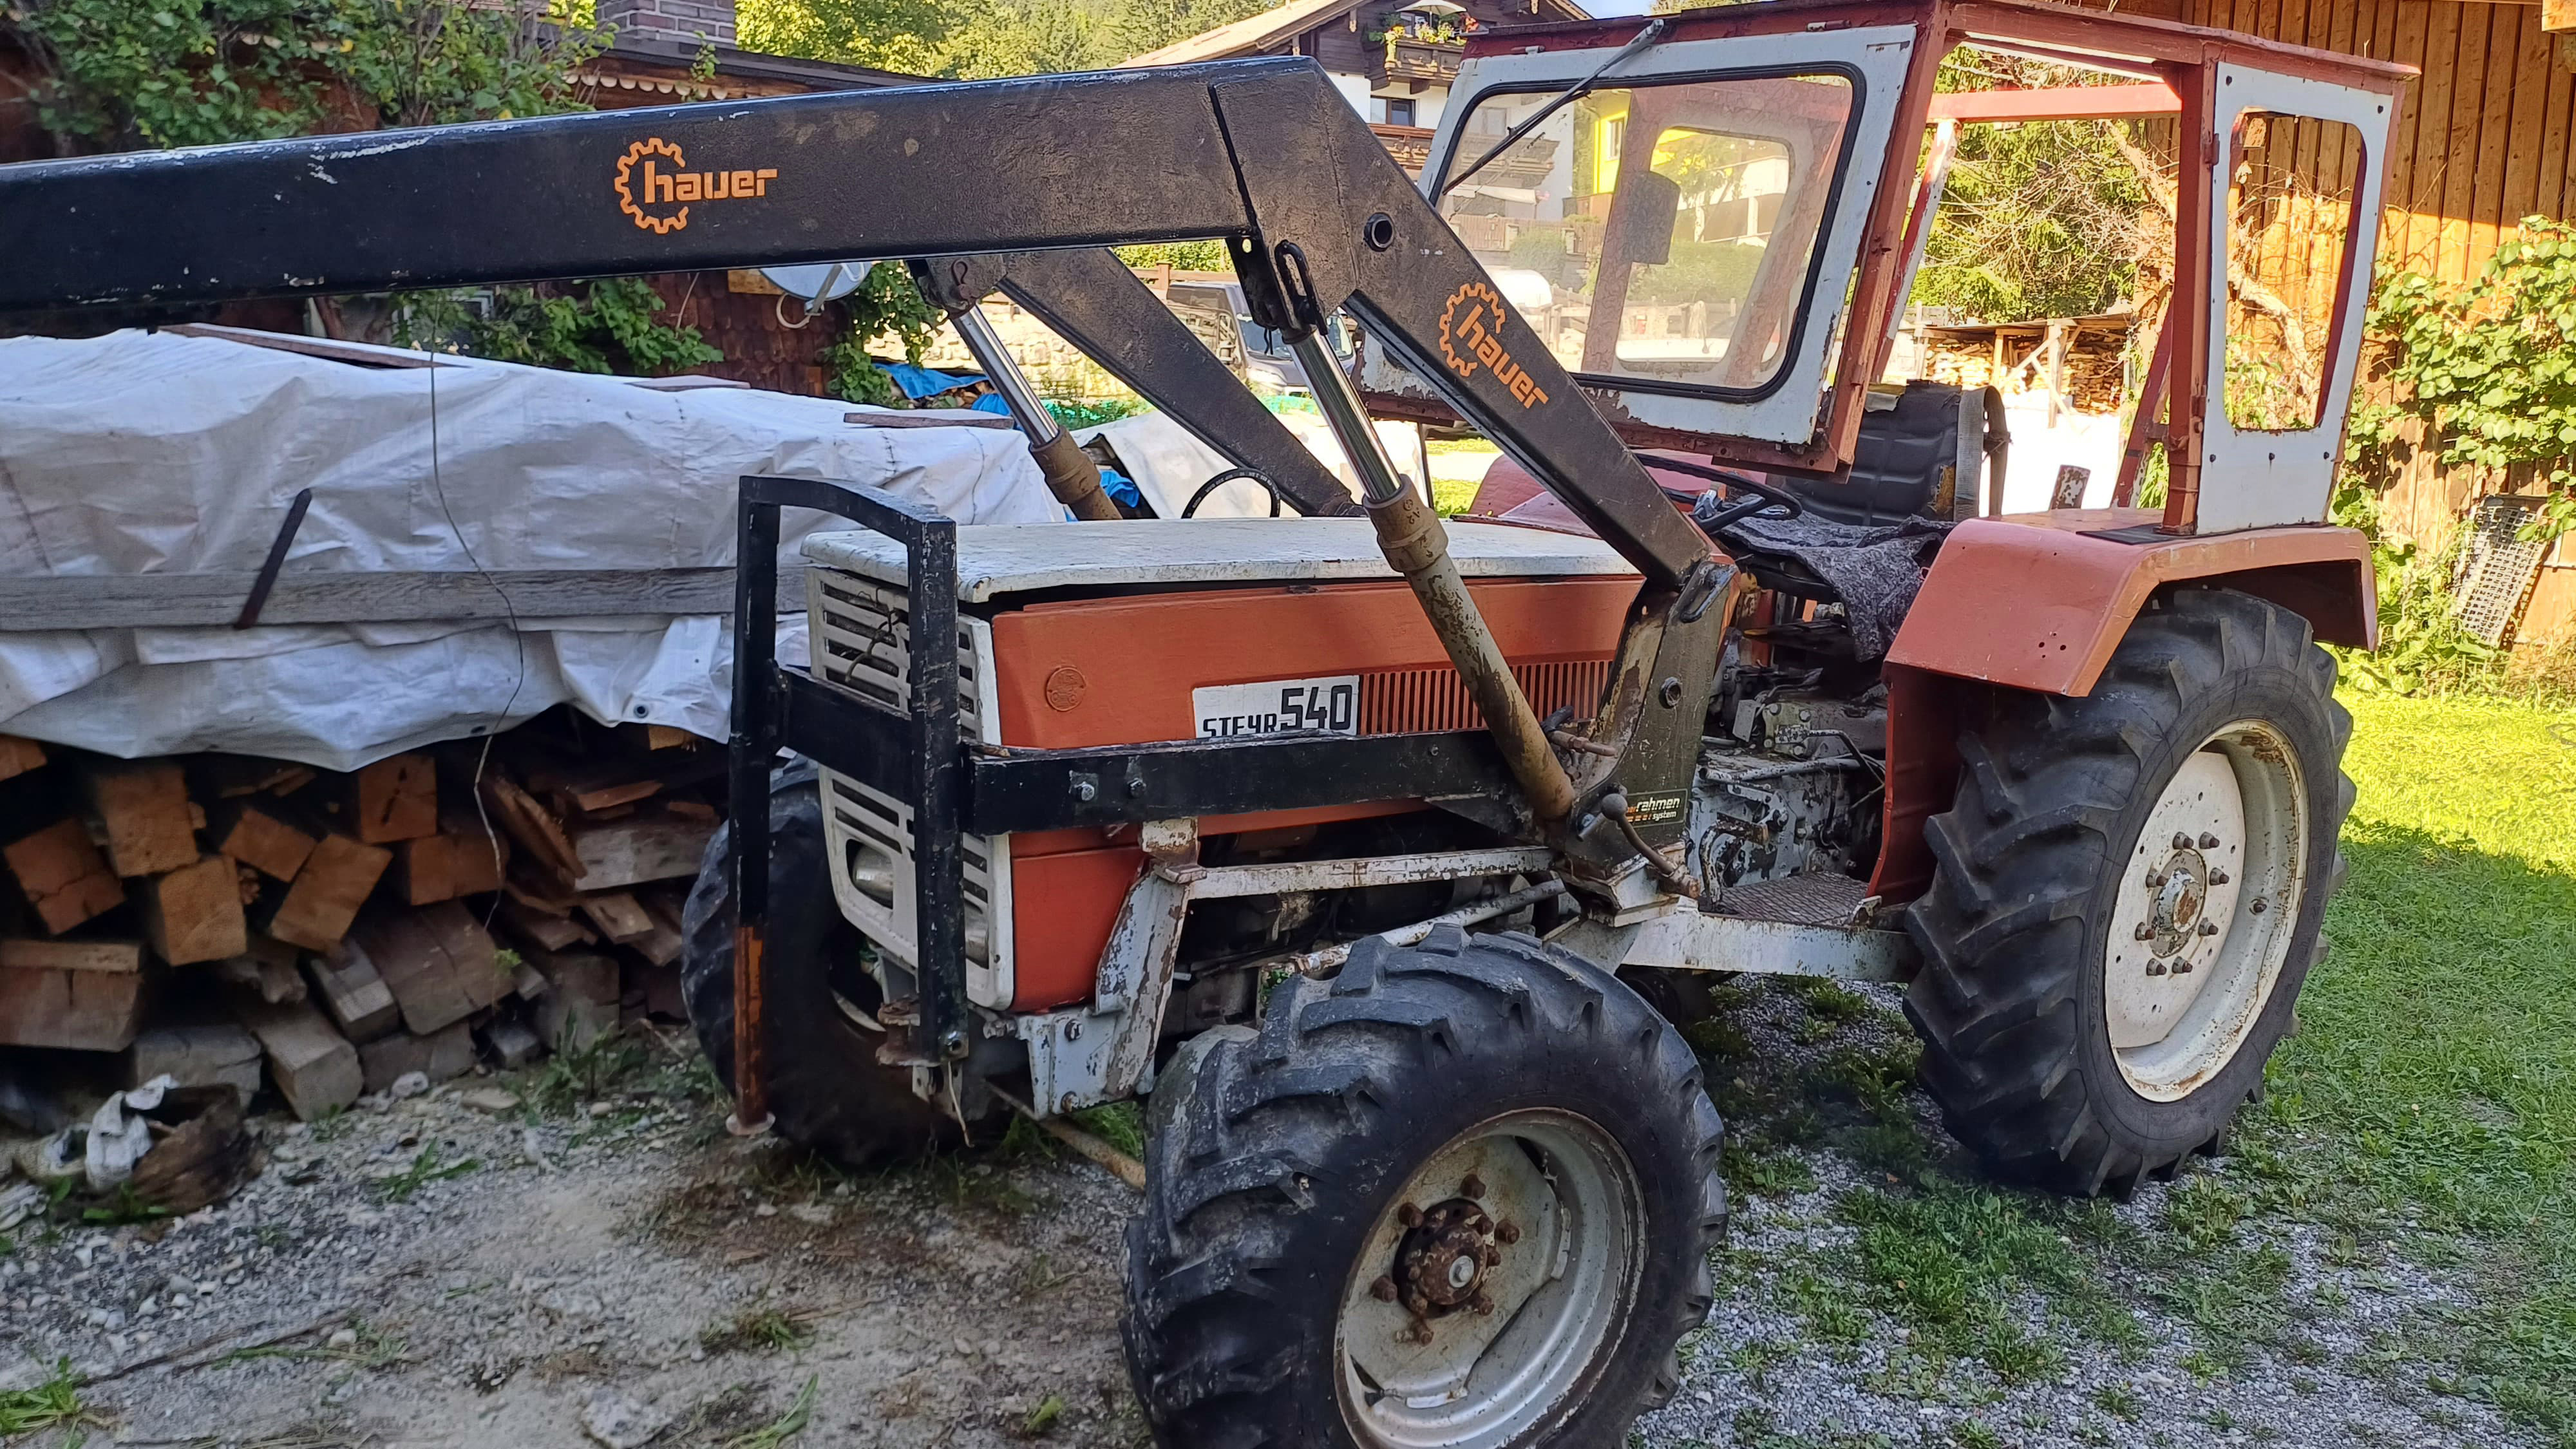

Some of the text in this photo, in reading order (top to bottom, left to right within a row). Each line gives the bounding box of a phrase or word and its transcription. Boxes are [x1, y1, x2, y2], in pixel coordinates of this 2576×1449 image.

[644, 160, 777, 204] hauer
[1455, 303, 1549, 409] hauer
[1202, 685, 1352, 737] STEYR 540
[1636, 797, 1680, 812] rahmen
[1652, 810, 1677, 821] system
